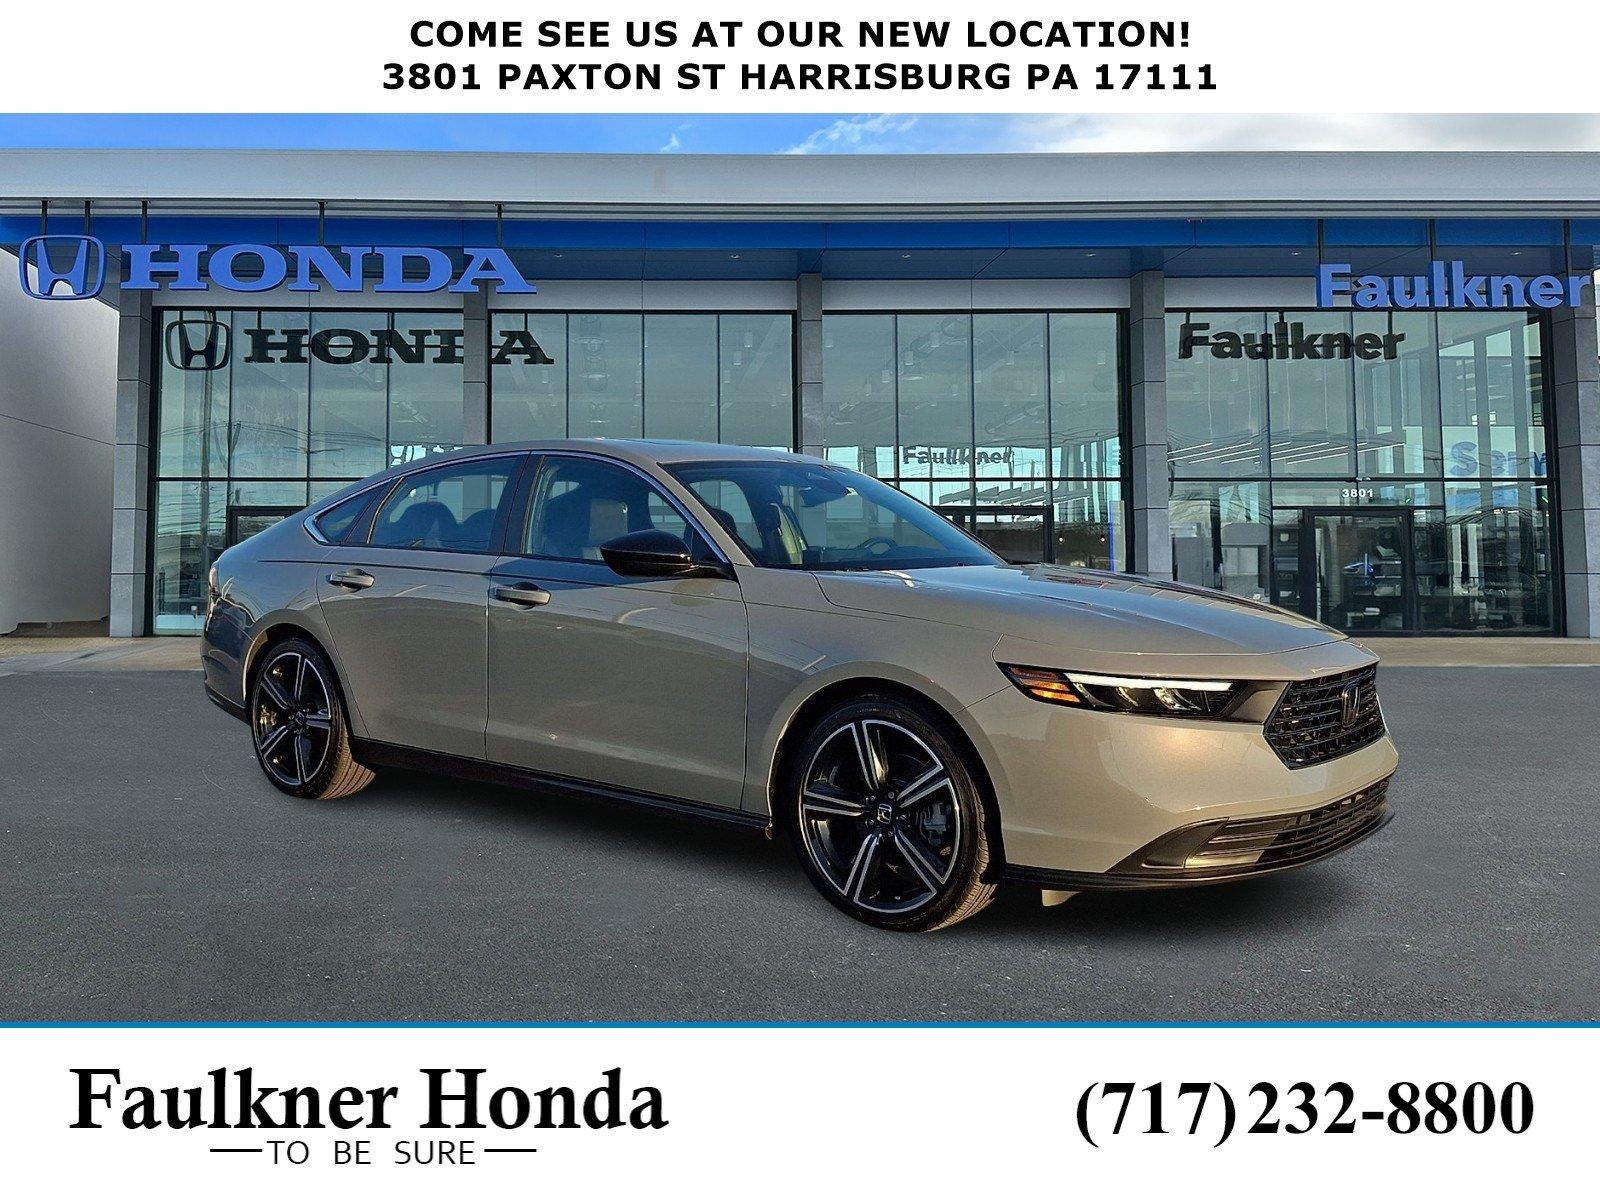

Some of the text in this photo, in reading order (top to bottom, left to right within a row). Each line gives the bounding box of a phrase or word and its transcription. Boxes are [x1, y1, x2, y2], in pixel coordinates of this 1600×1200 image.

[121, 243, 538, 295] HONDA
[1317, 260, 1592, 309] Faulkner
[1179, 322, 1406, 361] Faulkner
[1342, 488, 1373, 498] 3801
